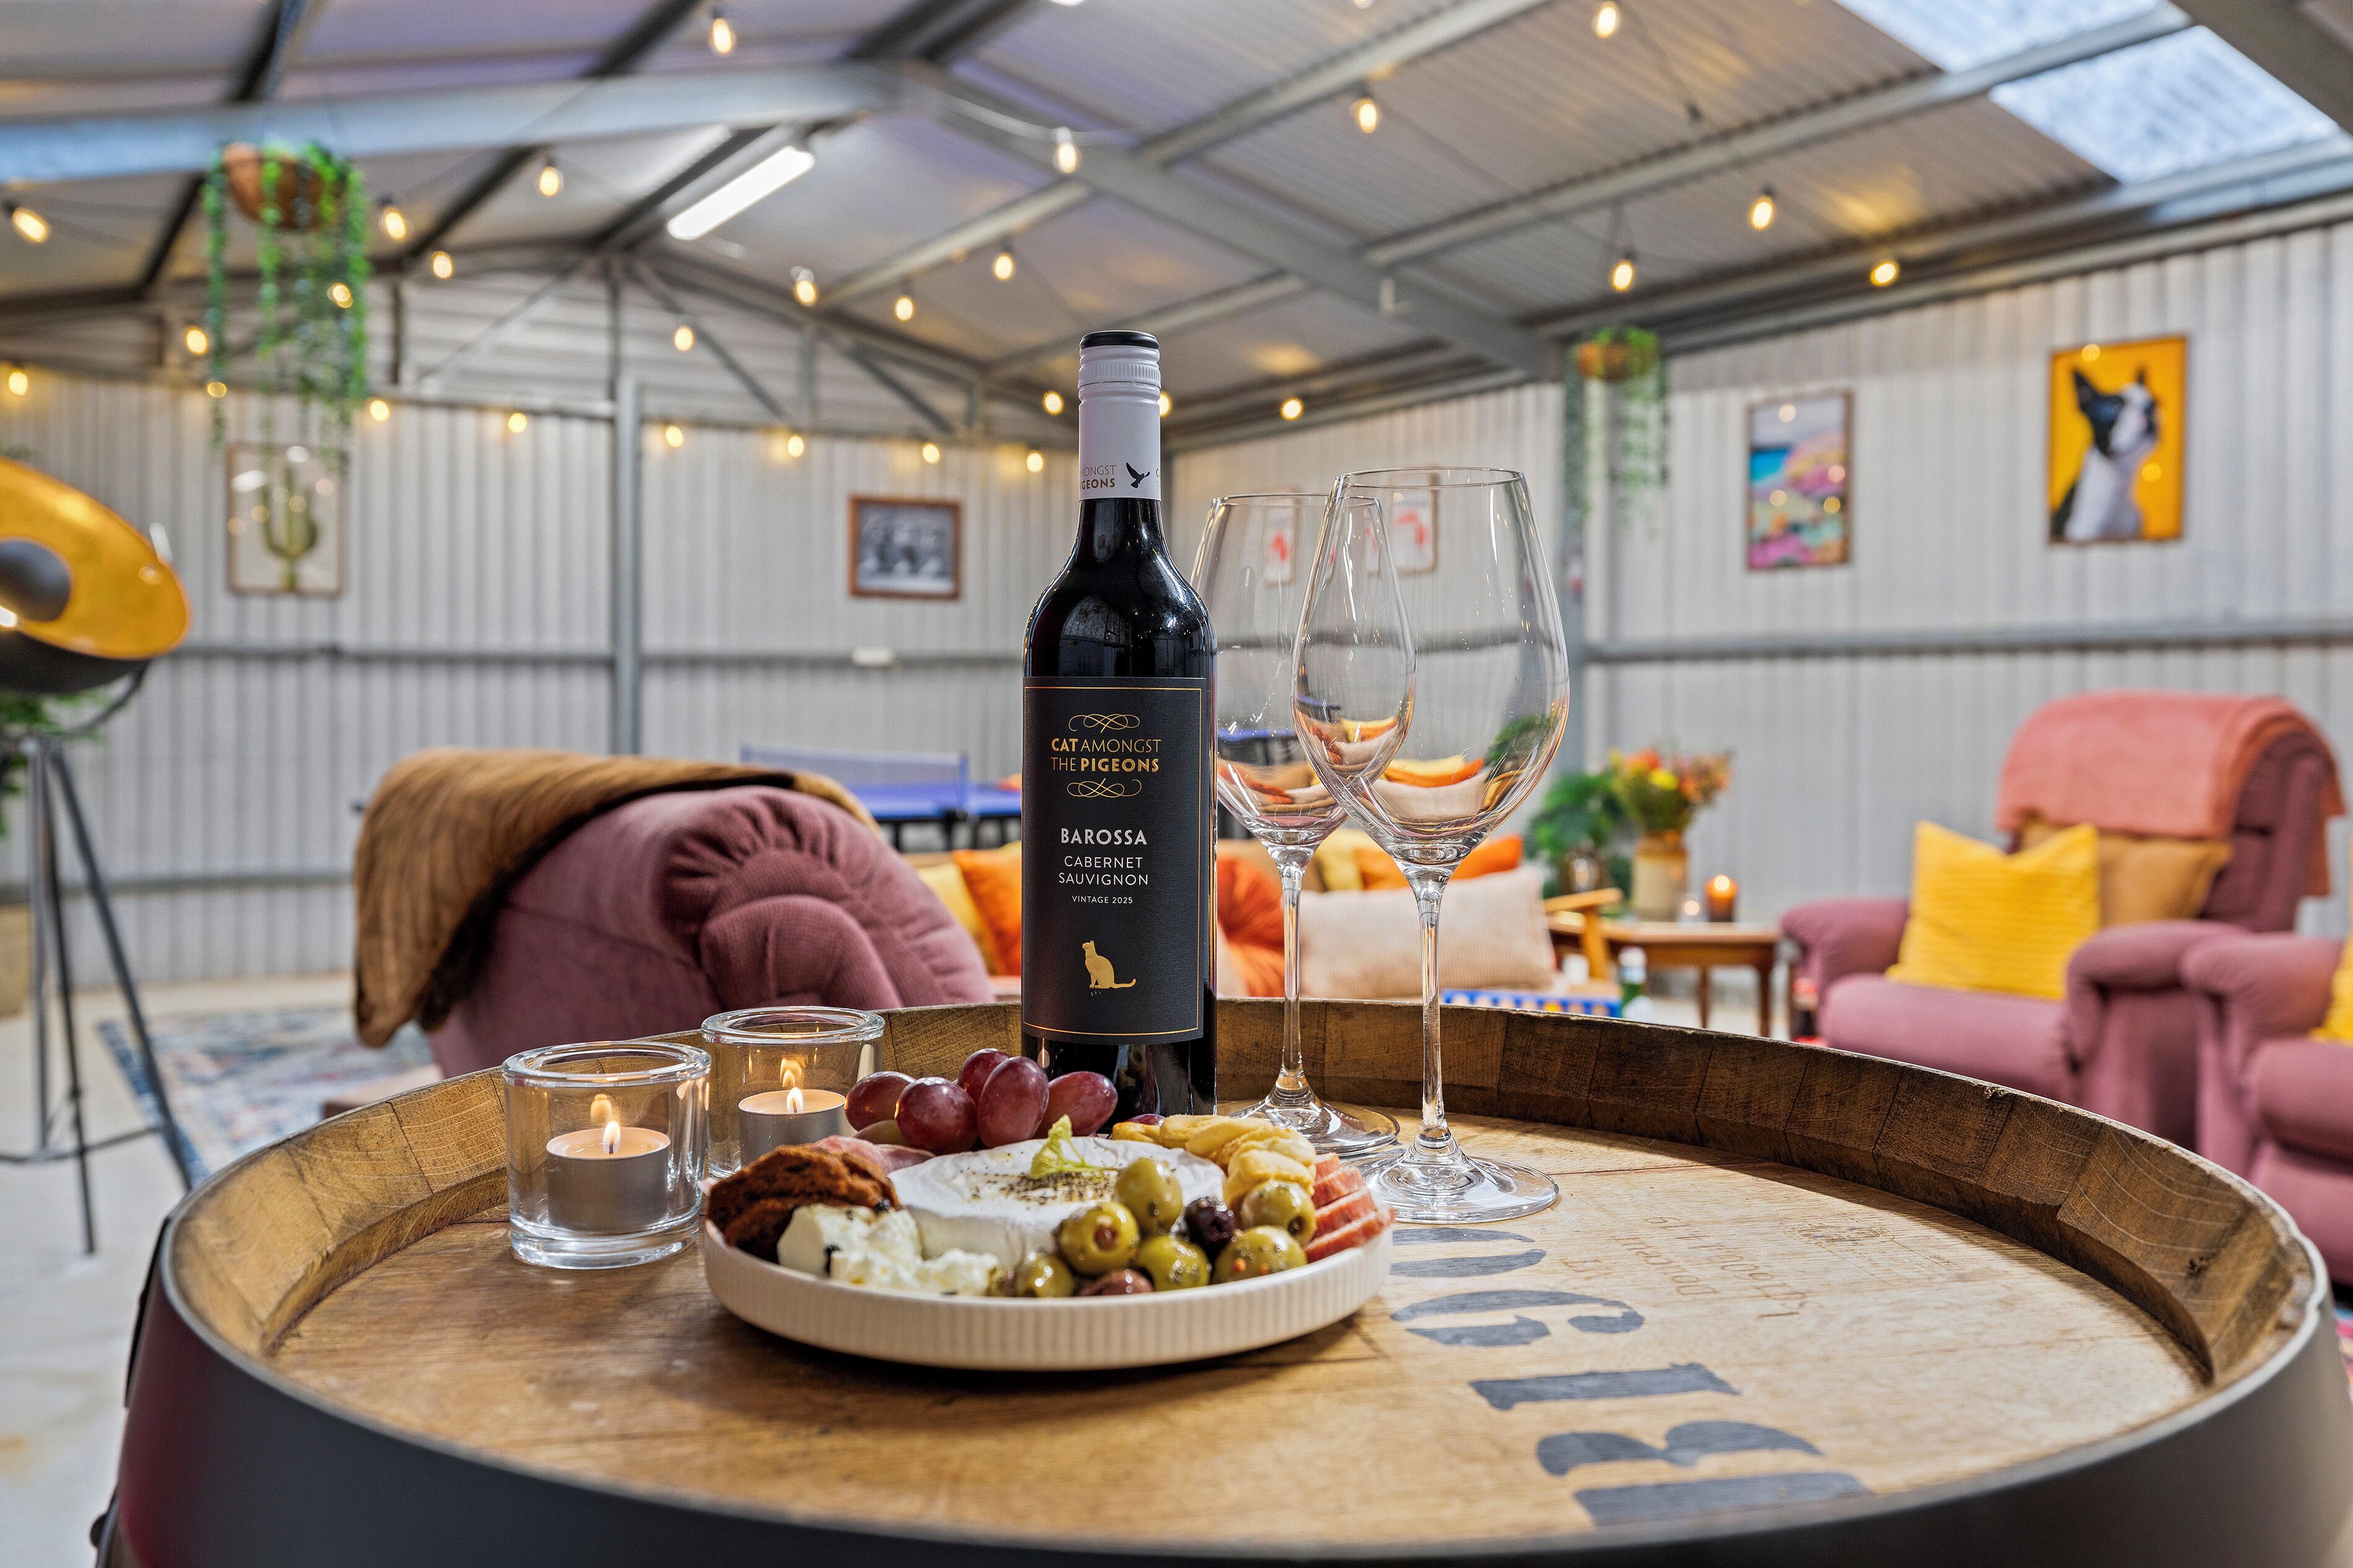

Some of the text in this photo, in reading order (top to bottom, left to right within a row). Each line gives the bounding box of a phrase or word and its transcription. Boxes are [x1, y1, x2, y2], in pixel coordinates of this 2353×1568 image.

[1051, 739, 1162, 753] CAT AMONGST
[1051, 758, 1159, 773] THE PIGEONS
[1061, 828, 1147, 846] BAROSSA
[1064, 855, 1143, 868] CABERNET
[1058, 872, 1148, 886] SAUVIGNON
[1072, 895, 1109, 904] VINTAGE
